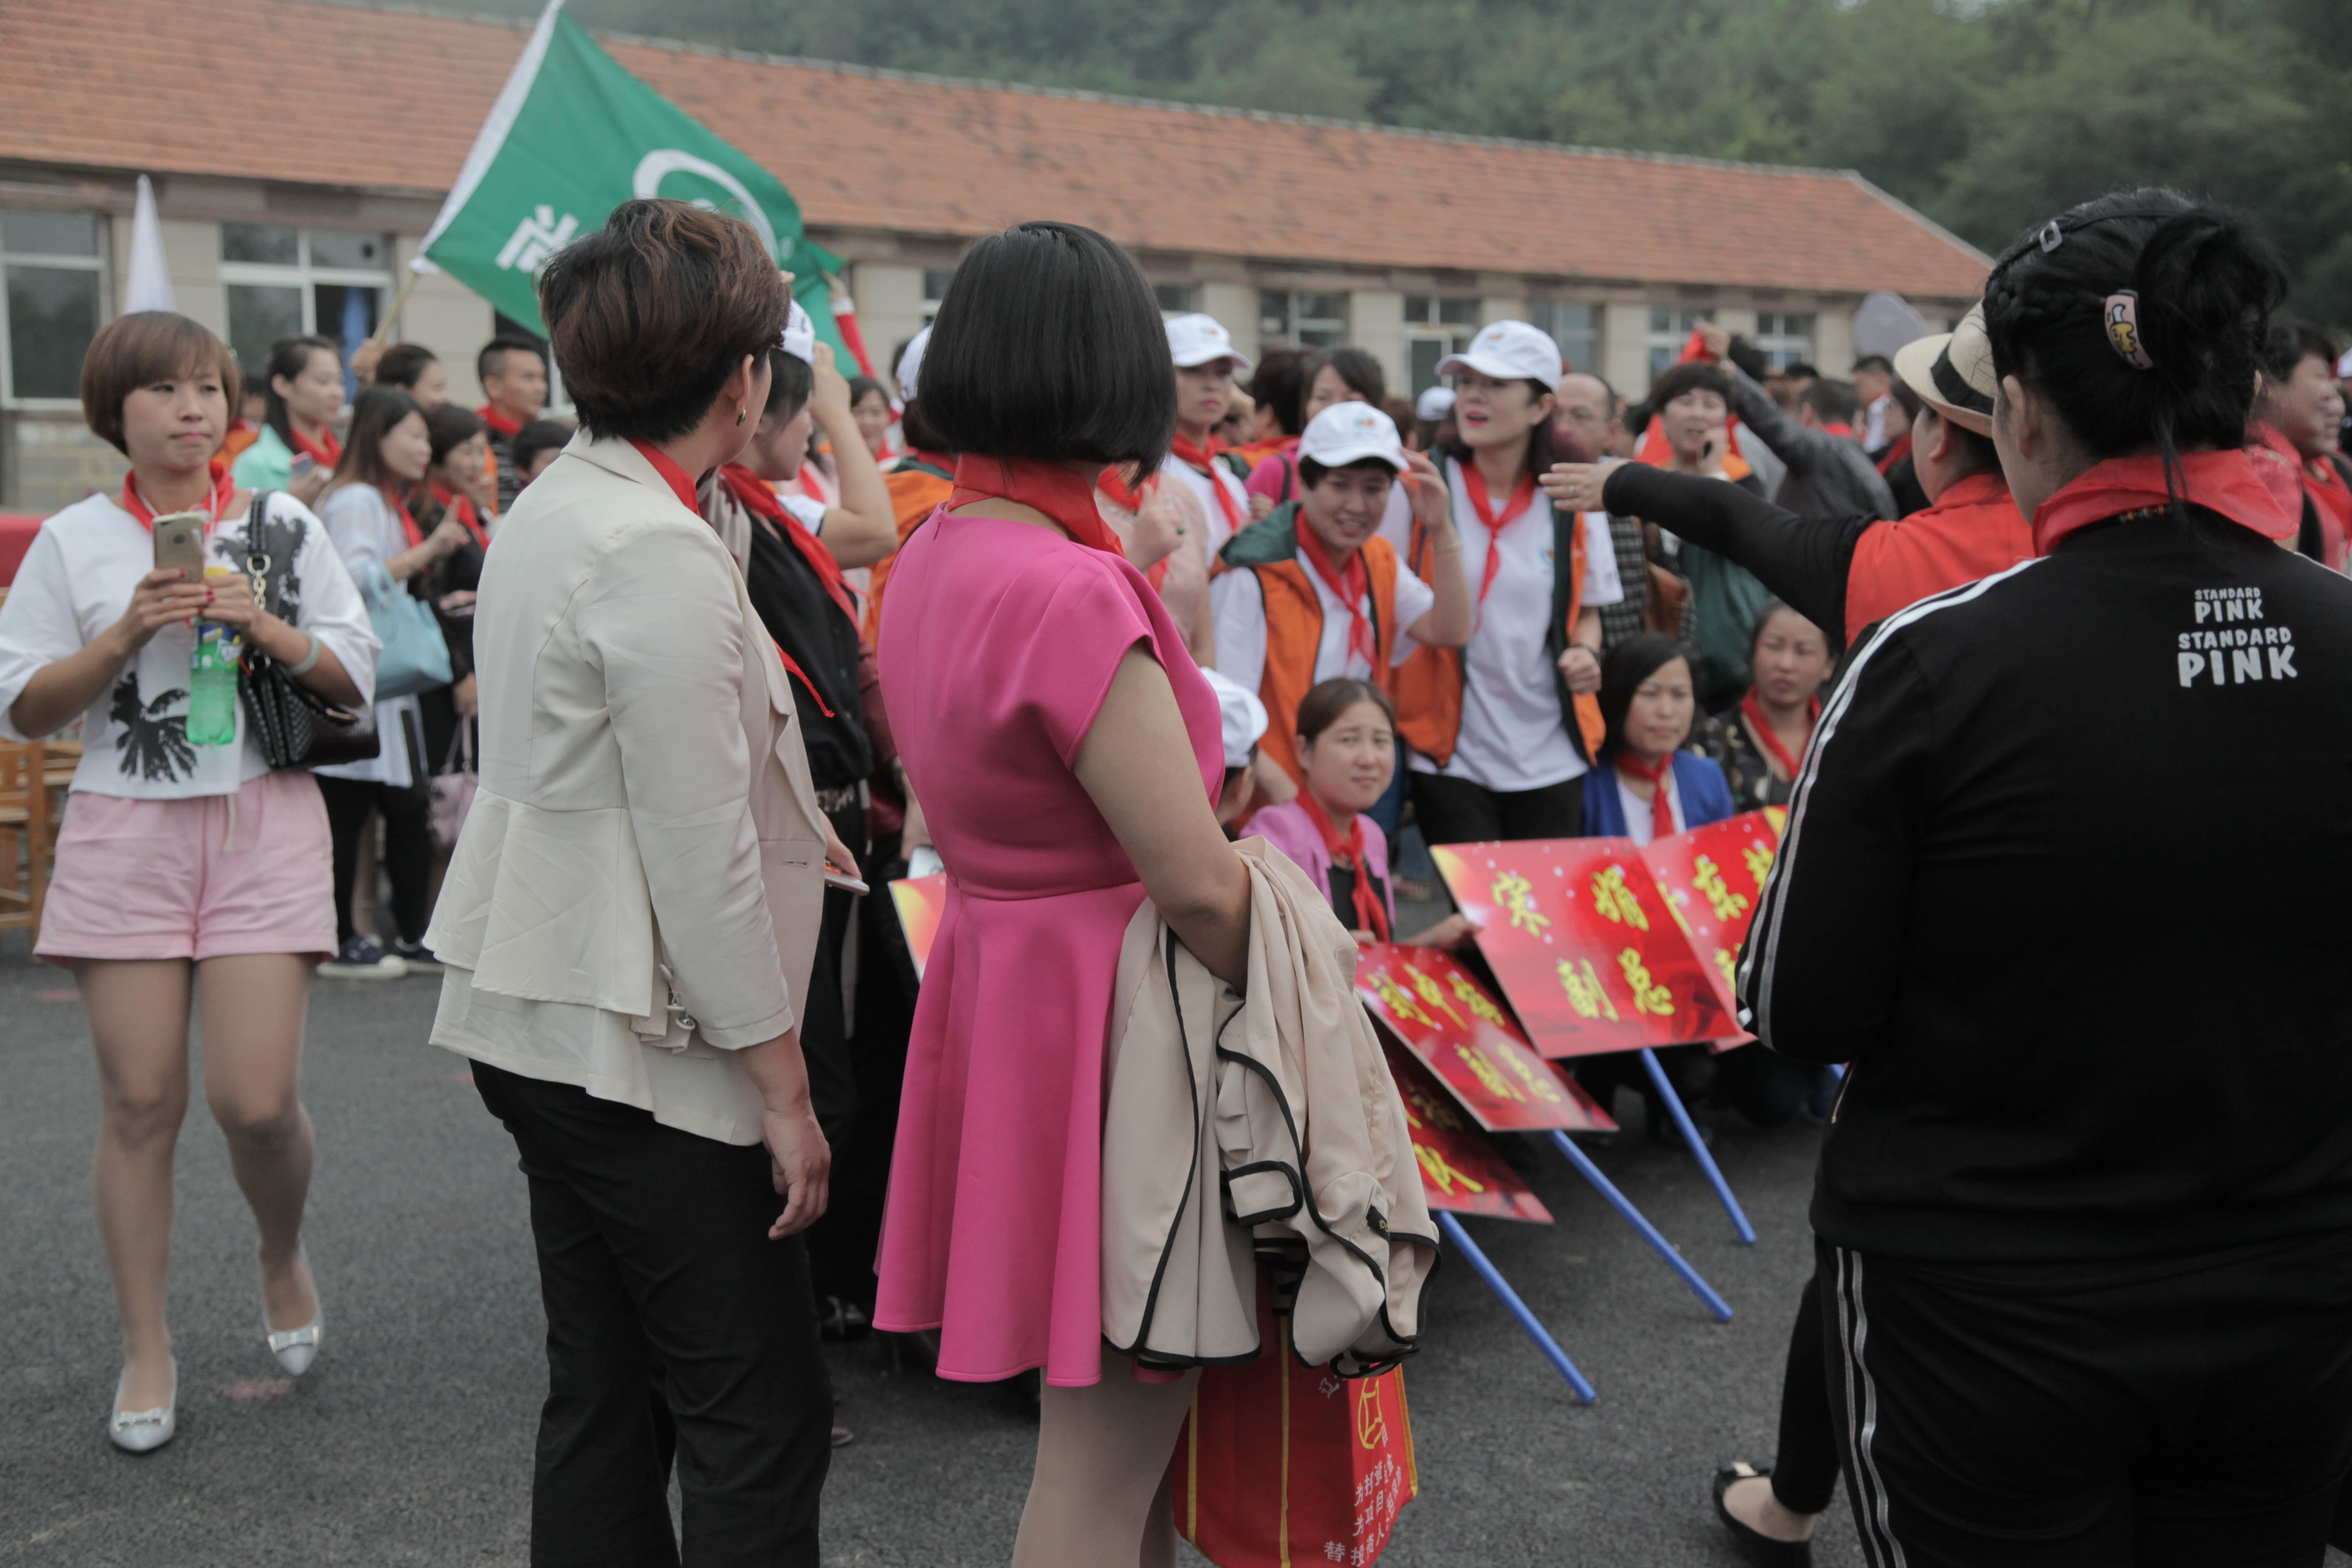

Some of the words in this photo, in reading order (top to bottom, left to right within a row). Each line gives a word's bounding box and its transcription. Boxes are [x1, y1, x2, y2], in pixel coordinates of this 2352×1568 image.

[2195, 588, 2260, 600] STANDARD
[2195, 599, 2264, 623] PINK
[2178, 627, 2291, 649] STANDARD
[2177, 645, 2298, 687] PINK
